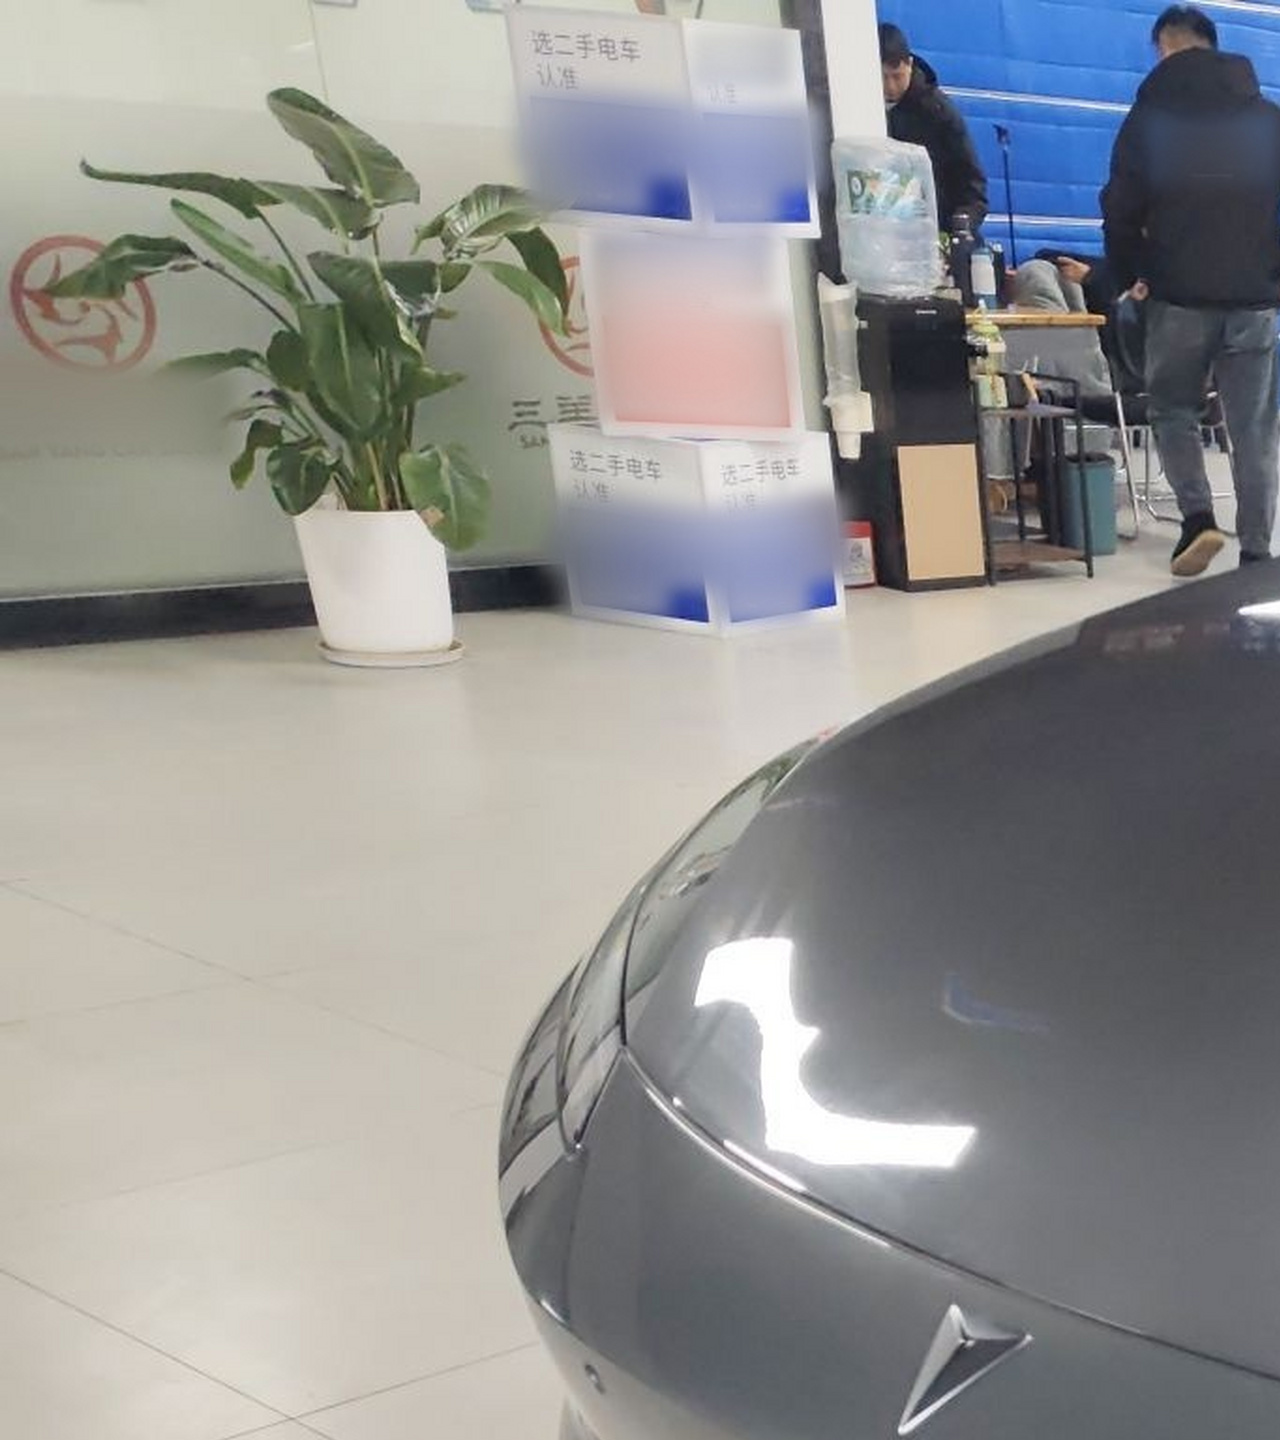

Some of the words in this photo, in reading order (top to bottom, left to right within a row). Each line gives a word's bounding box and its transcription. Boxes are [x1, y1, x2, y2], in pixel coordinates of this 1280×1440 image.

[531, 30, 641, 62] 选二手电车
[535, 63, 579, 90] 认准
[569, 449, 661, 481] 选二手电车
[719, 458, 800, 485] 选二手电车
